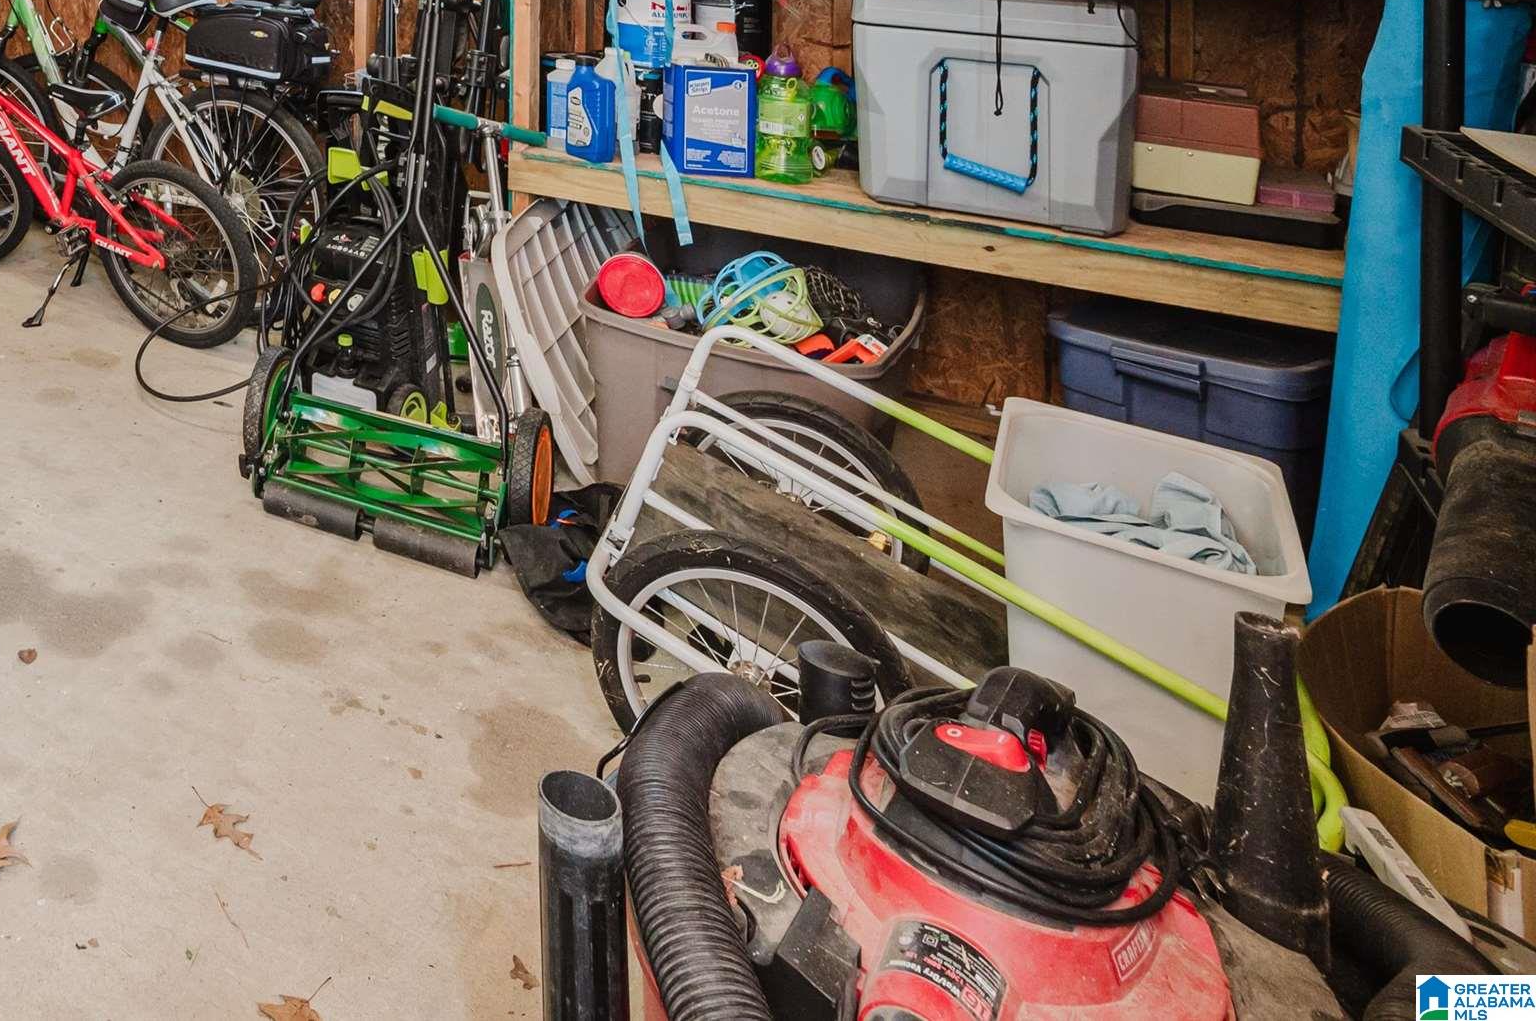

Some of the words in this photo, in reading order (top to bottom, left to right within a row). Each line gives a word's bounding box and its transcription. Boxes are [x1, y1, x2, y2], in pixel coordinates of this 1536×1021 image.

[692, 105, 740, 116] Acetone
[94, 238, 133, 258] GIANT
[480, 309, 497, 369] Razor
